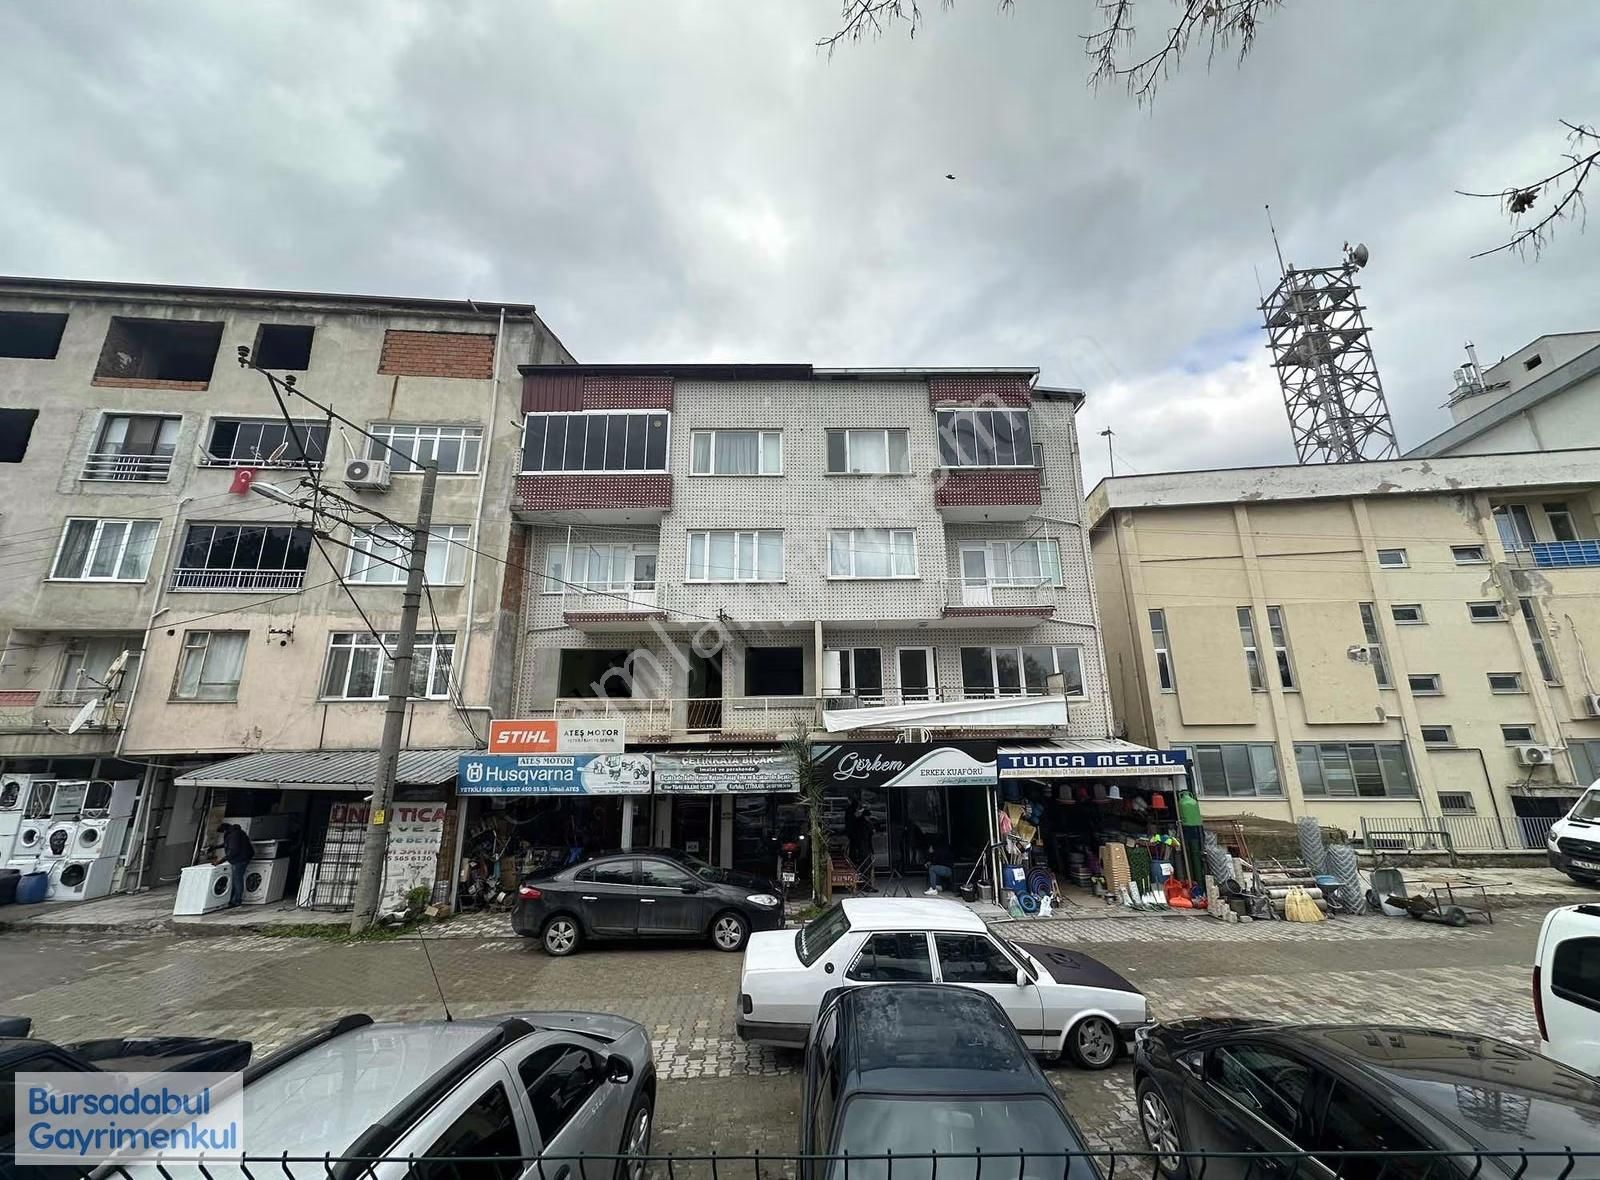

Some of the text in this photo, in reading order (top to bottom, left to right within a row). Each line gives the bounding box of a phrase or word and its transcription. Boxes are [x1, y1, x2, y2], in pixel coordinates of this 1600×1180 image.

[496, 730, 550, 744] STIHL
[564, 730, 585, 738] ATEŞ
[520, 757, 573, 766] ATEŞ MOTOR
[833, 752, 905, 780] Görkem
[1009, 753, 1176, 768] TUNCA METAL
[486, 766, 573, 785] Husqvarna
[920, 768, 945, 777] ERKEK
